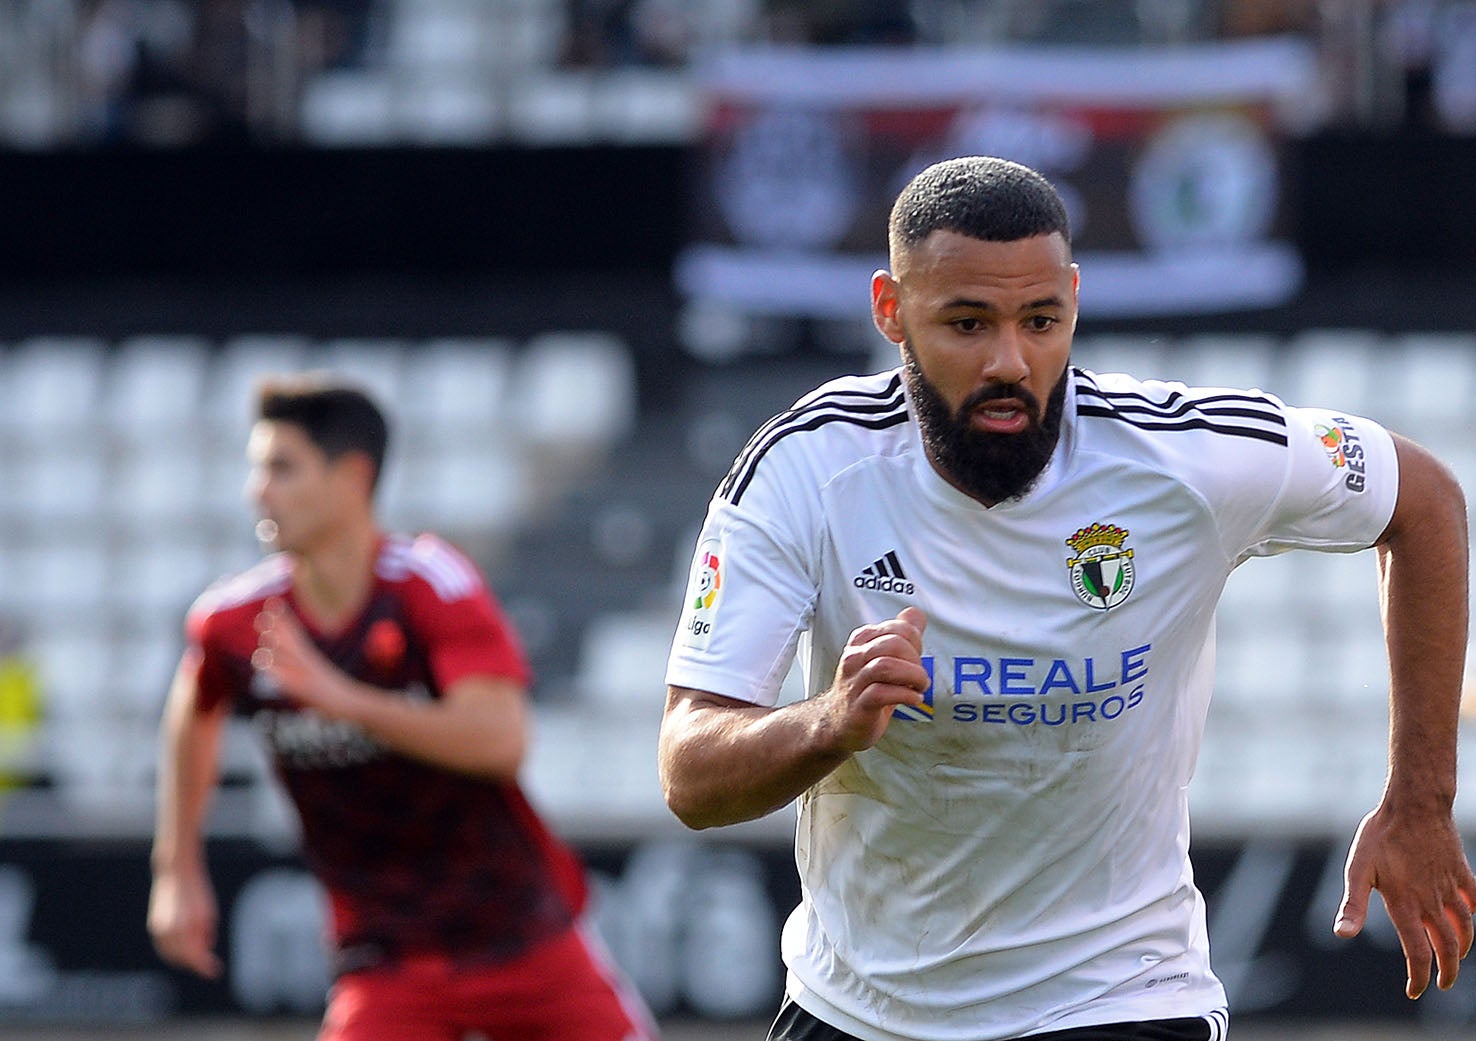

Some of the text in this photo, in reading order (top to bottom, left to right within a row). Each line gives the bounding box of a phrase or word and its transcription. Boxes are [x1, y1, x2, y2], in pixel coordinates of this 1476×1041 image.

[854, 575, 914, 595] adidas
[953, 643, 1152, 695] REALE
[952, 683, 1145, 726] SEGUROS
